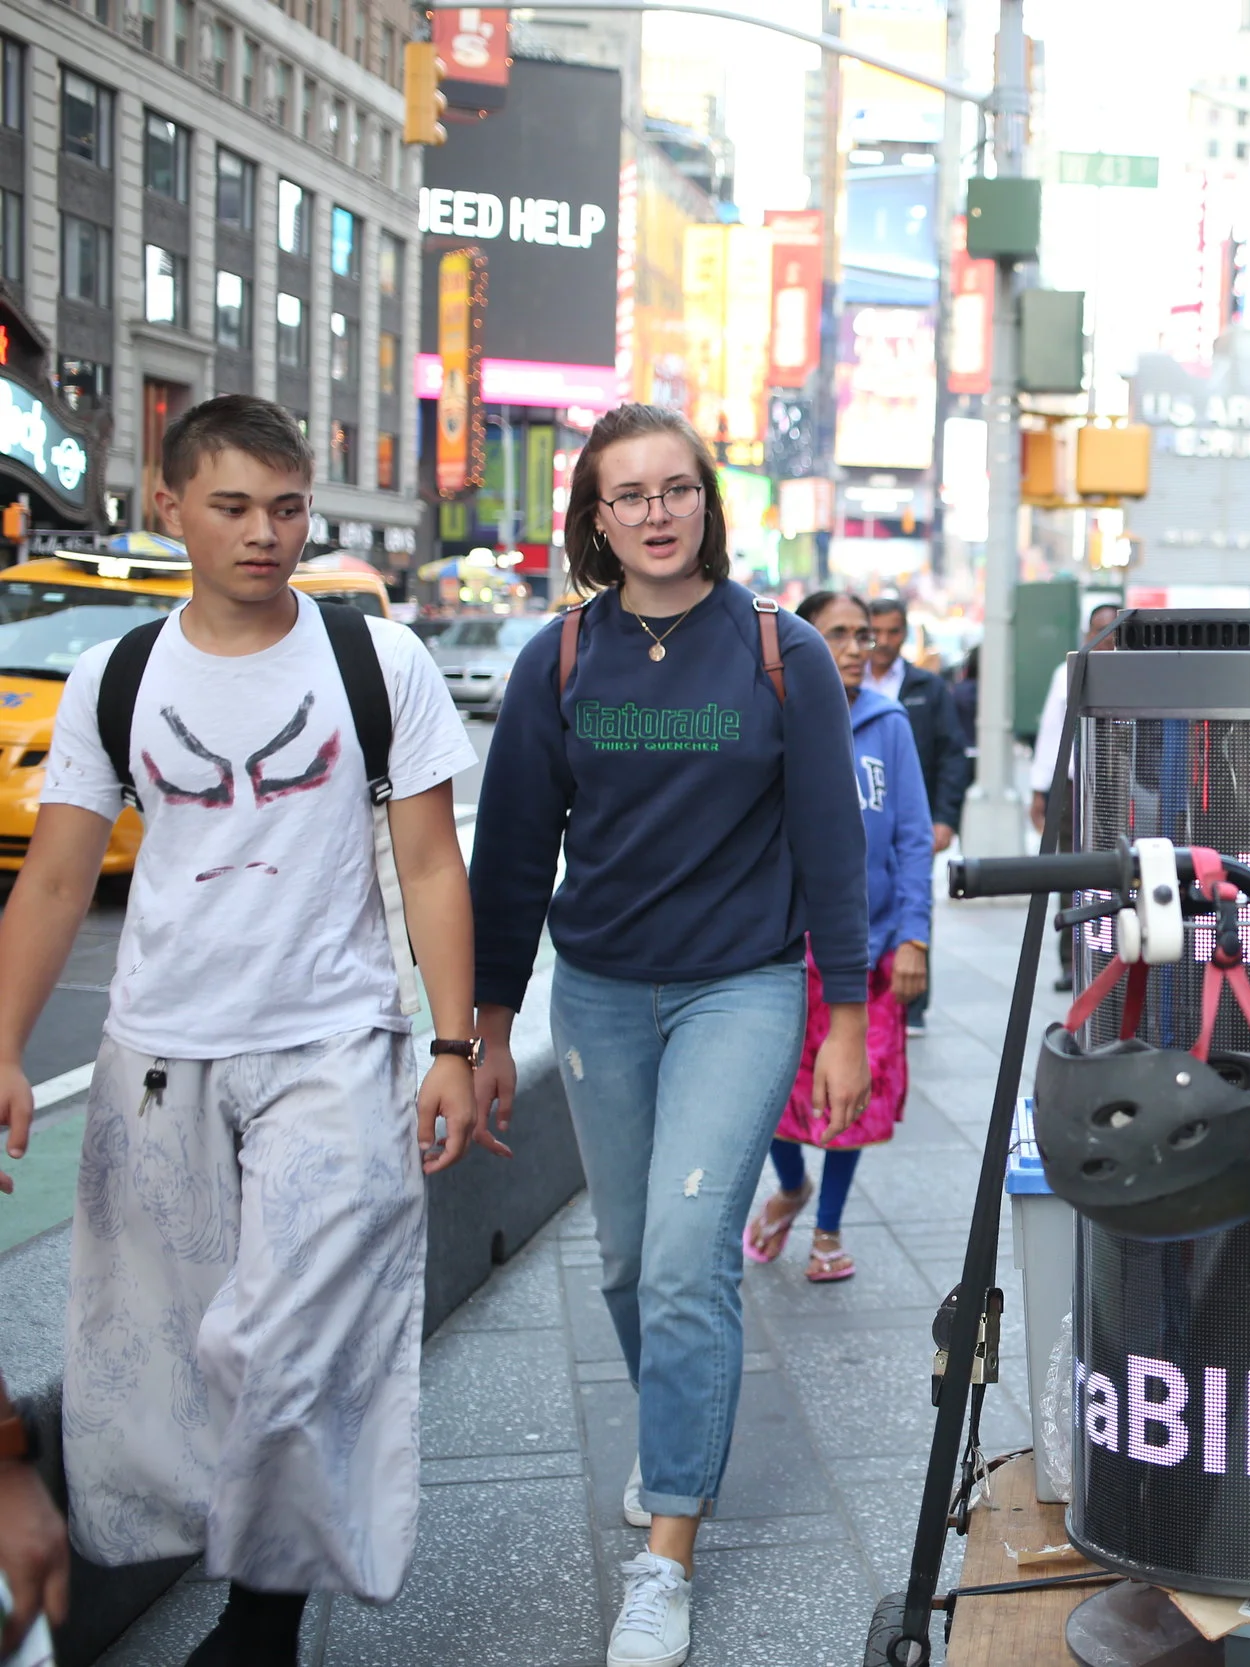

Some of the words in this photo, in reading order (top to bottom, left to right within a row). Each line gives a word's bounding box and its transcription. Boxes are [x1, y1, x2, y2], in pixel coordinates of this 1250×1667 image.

[509, 196, 606, 249] HELP
[576, 700, 740, 740] Gatorade
[593, 741, 638, 751] THIRST
[645, 741, 720, 751] QUENCHER
